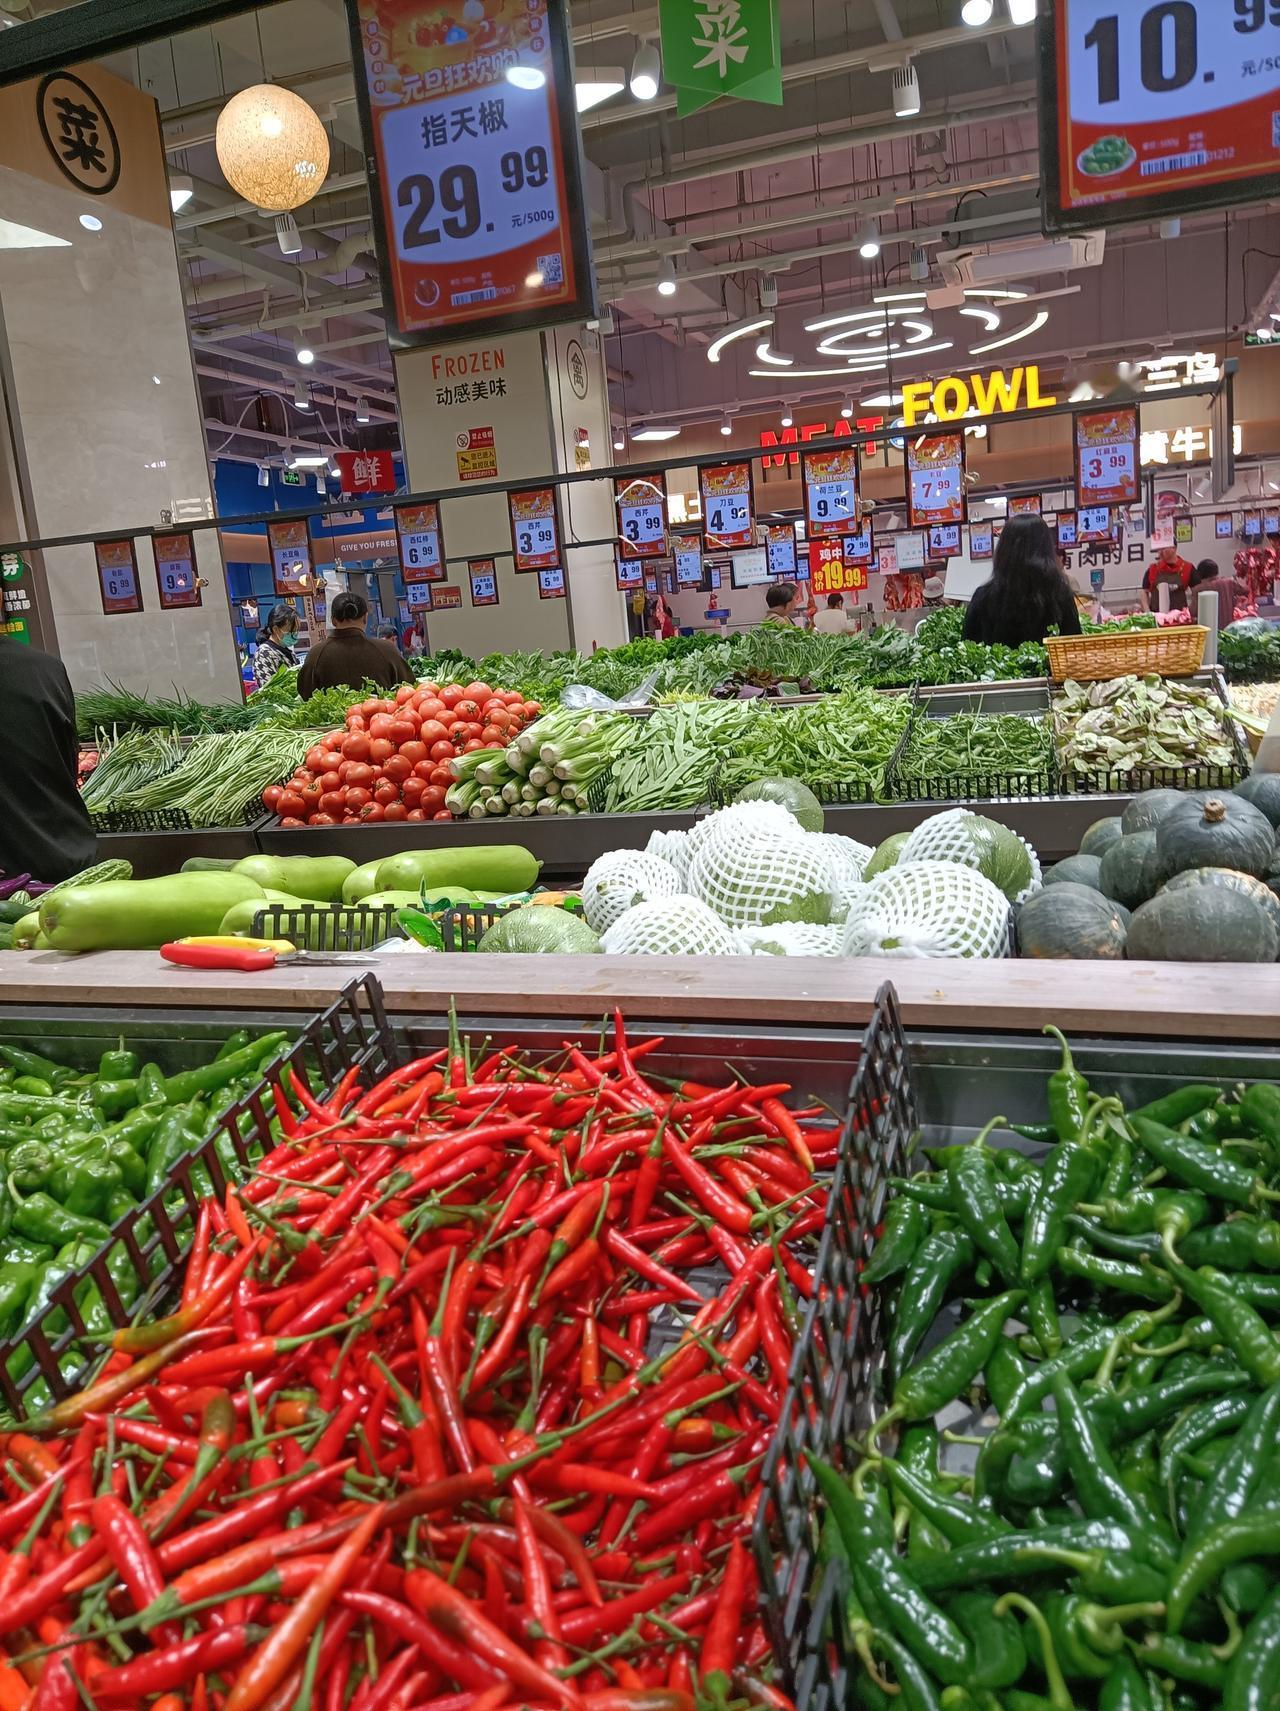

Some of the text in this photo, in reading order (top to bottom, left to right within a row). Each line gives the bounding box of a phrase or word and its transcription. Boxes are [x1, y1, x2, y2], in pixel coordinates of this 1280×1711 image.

[52, 96, 107, 174] 菜
[421, 98, 509, 149] 指天椒
[511, 209, 554, 228] 元/500g
[431, 349, 505, 380] FROZEN
[436, 377, 507, 406] 动感美味
[902, 364, 1056, 427] FOWL
[352, 455, 383, 486] 鲜
[527, 521, 541, 530] 西芹
[341, 543, 358, 552] GIVE
[359, 541, 375, 550] YOU
[822, 561, 861, 590] 19.99
